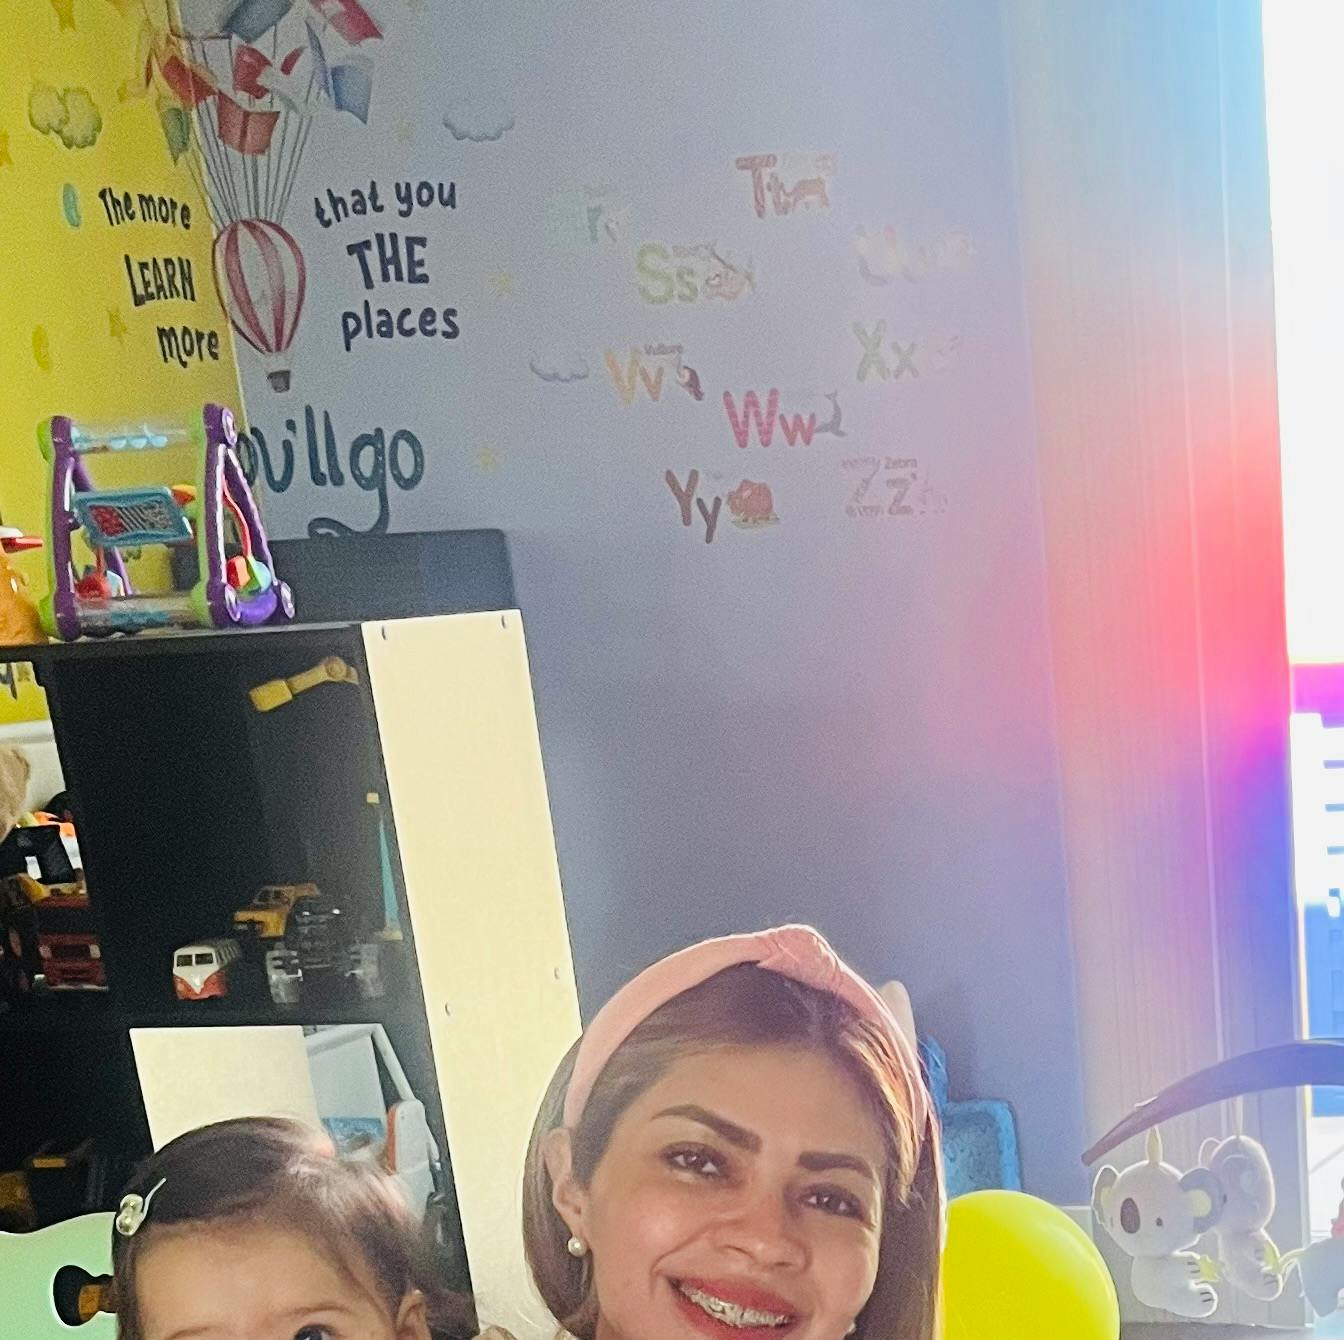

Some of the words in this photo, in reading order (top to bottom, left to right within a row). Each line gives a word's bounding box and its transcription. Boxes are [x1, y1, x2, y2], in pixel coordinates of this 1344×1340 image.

[99, 188, 134, 227] The
[138, 194, 191, 231] more
[314, 180, 384, 229] that
[395, 181, 457, 223] you
[125, 254, 195, 306] LEARN
[347, 233, 430, 291] THE
[157, 325, 219, 368] more
[341, 300, 460, 352] places
